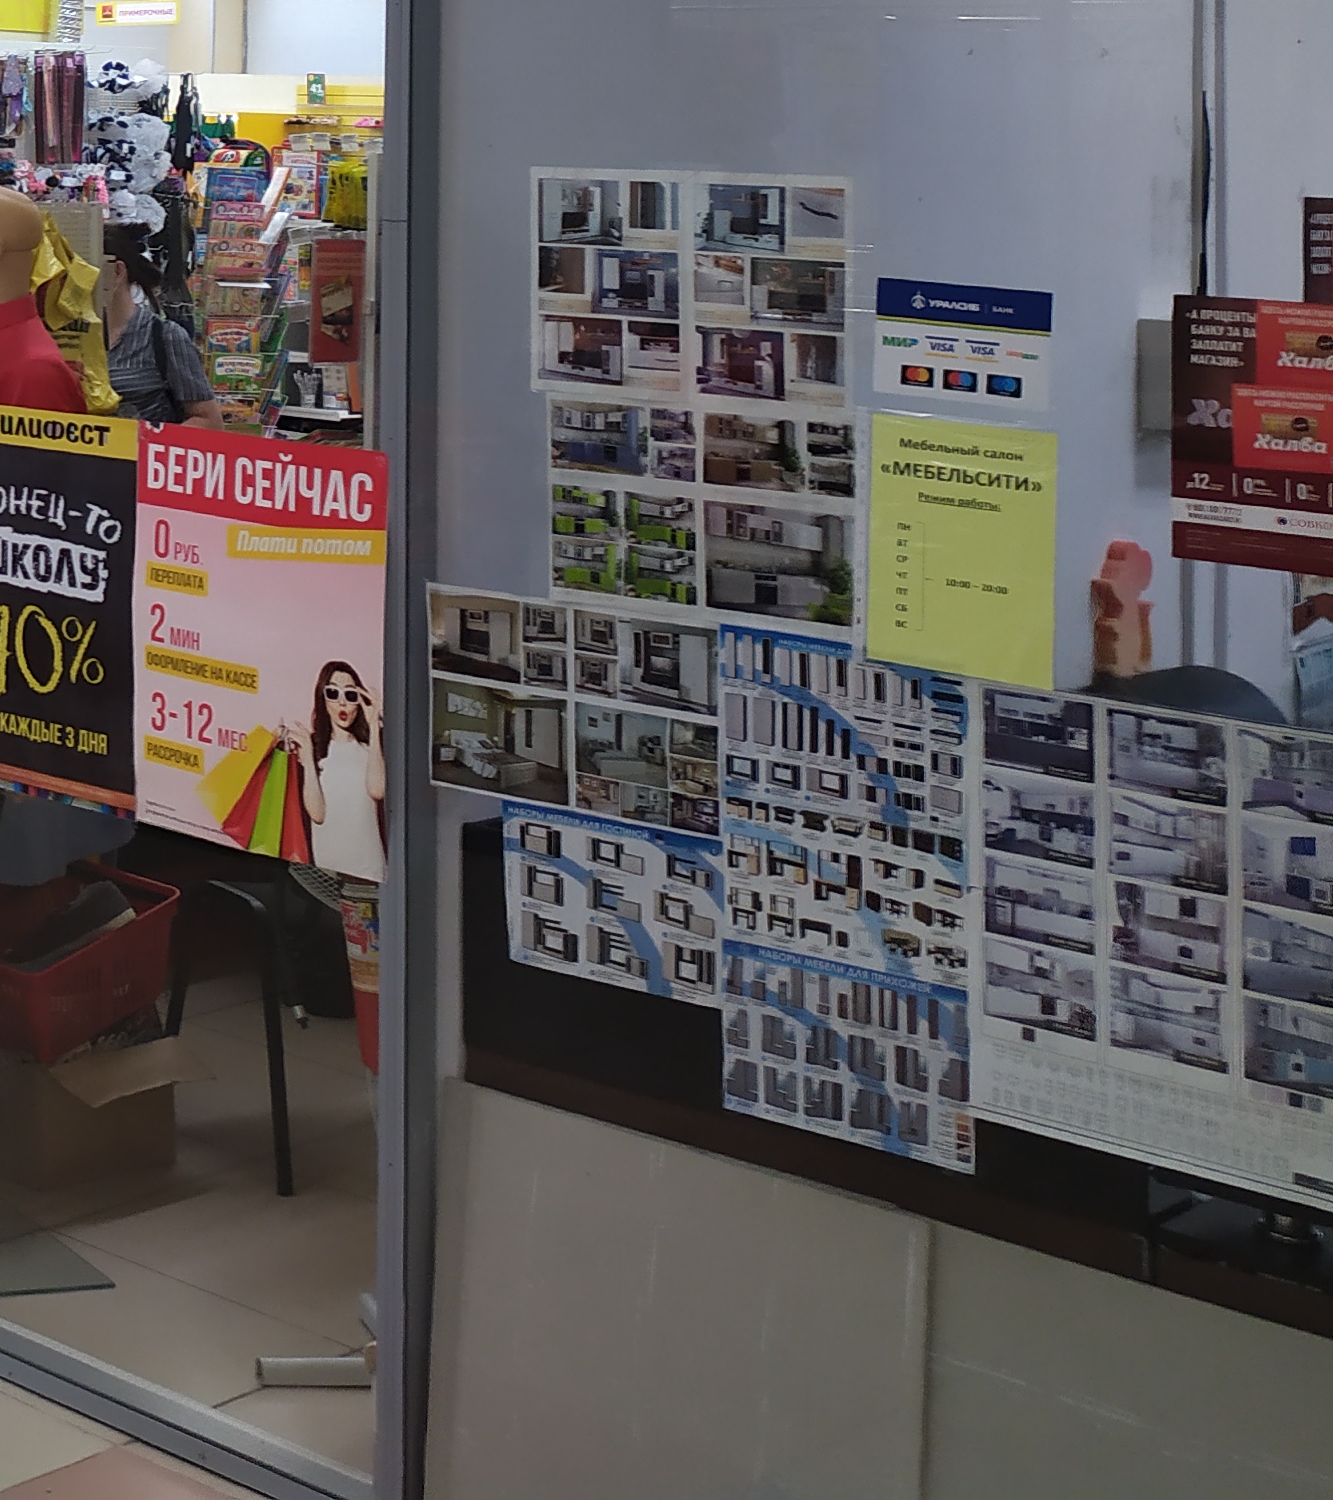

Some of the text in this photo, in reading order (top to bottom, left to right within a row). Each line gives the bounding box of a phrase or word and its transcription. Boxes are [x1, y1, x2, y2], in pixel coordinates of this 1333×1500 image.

[1190, 324, 1225, 335] БАНКУ
[1226, 326, 1241, 337] ЗА
[929, 341, 955, 352] VISA
[970, 345, 996, 356] VISA
[1190, 339, 1244, 352] ЗАПЛАТИТ
[899, 437, 1023, 462] Мебельный салон
[1253, 433, 1327, 455] Халва
[147, 442, 374, 522] БЕРИ СЕЙЧАС
[880, 460, 1043, 493] «МЕБЕЛЬСИТИ»
[154, 518, 204, 566] 0 РУБ.
[236, 529, 372, 556] Плати потом
[149, 566, 205, 591] ПЕРЕПЛАТА
[945, 577, 971, 590] 10:00
[150, 603, 201, 651] 2 МИН
[146, 651, 258, 690] ОФОРМЛЕНИЕ НА КАССЕ
[151, 691, 213, 745] 3-12
[0, 712, 63, 745] КАЖДЫЕ
[65, 727, 75, 748] 3
[78, 729, 108, 756] ДНЯ
[146, 742, 201, 769] РАССРОЧКА
[758, 948, 801, 964] НАБОРЫ
[804, 957, 844, 974] МЕБЕЛИ
[847, 967, 869, 980] ДЛЯ
